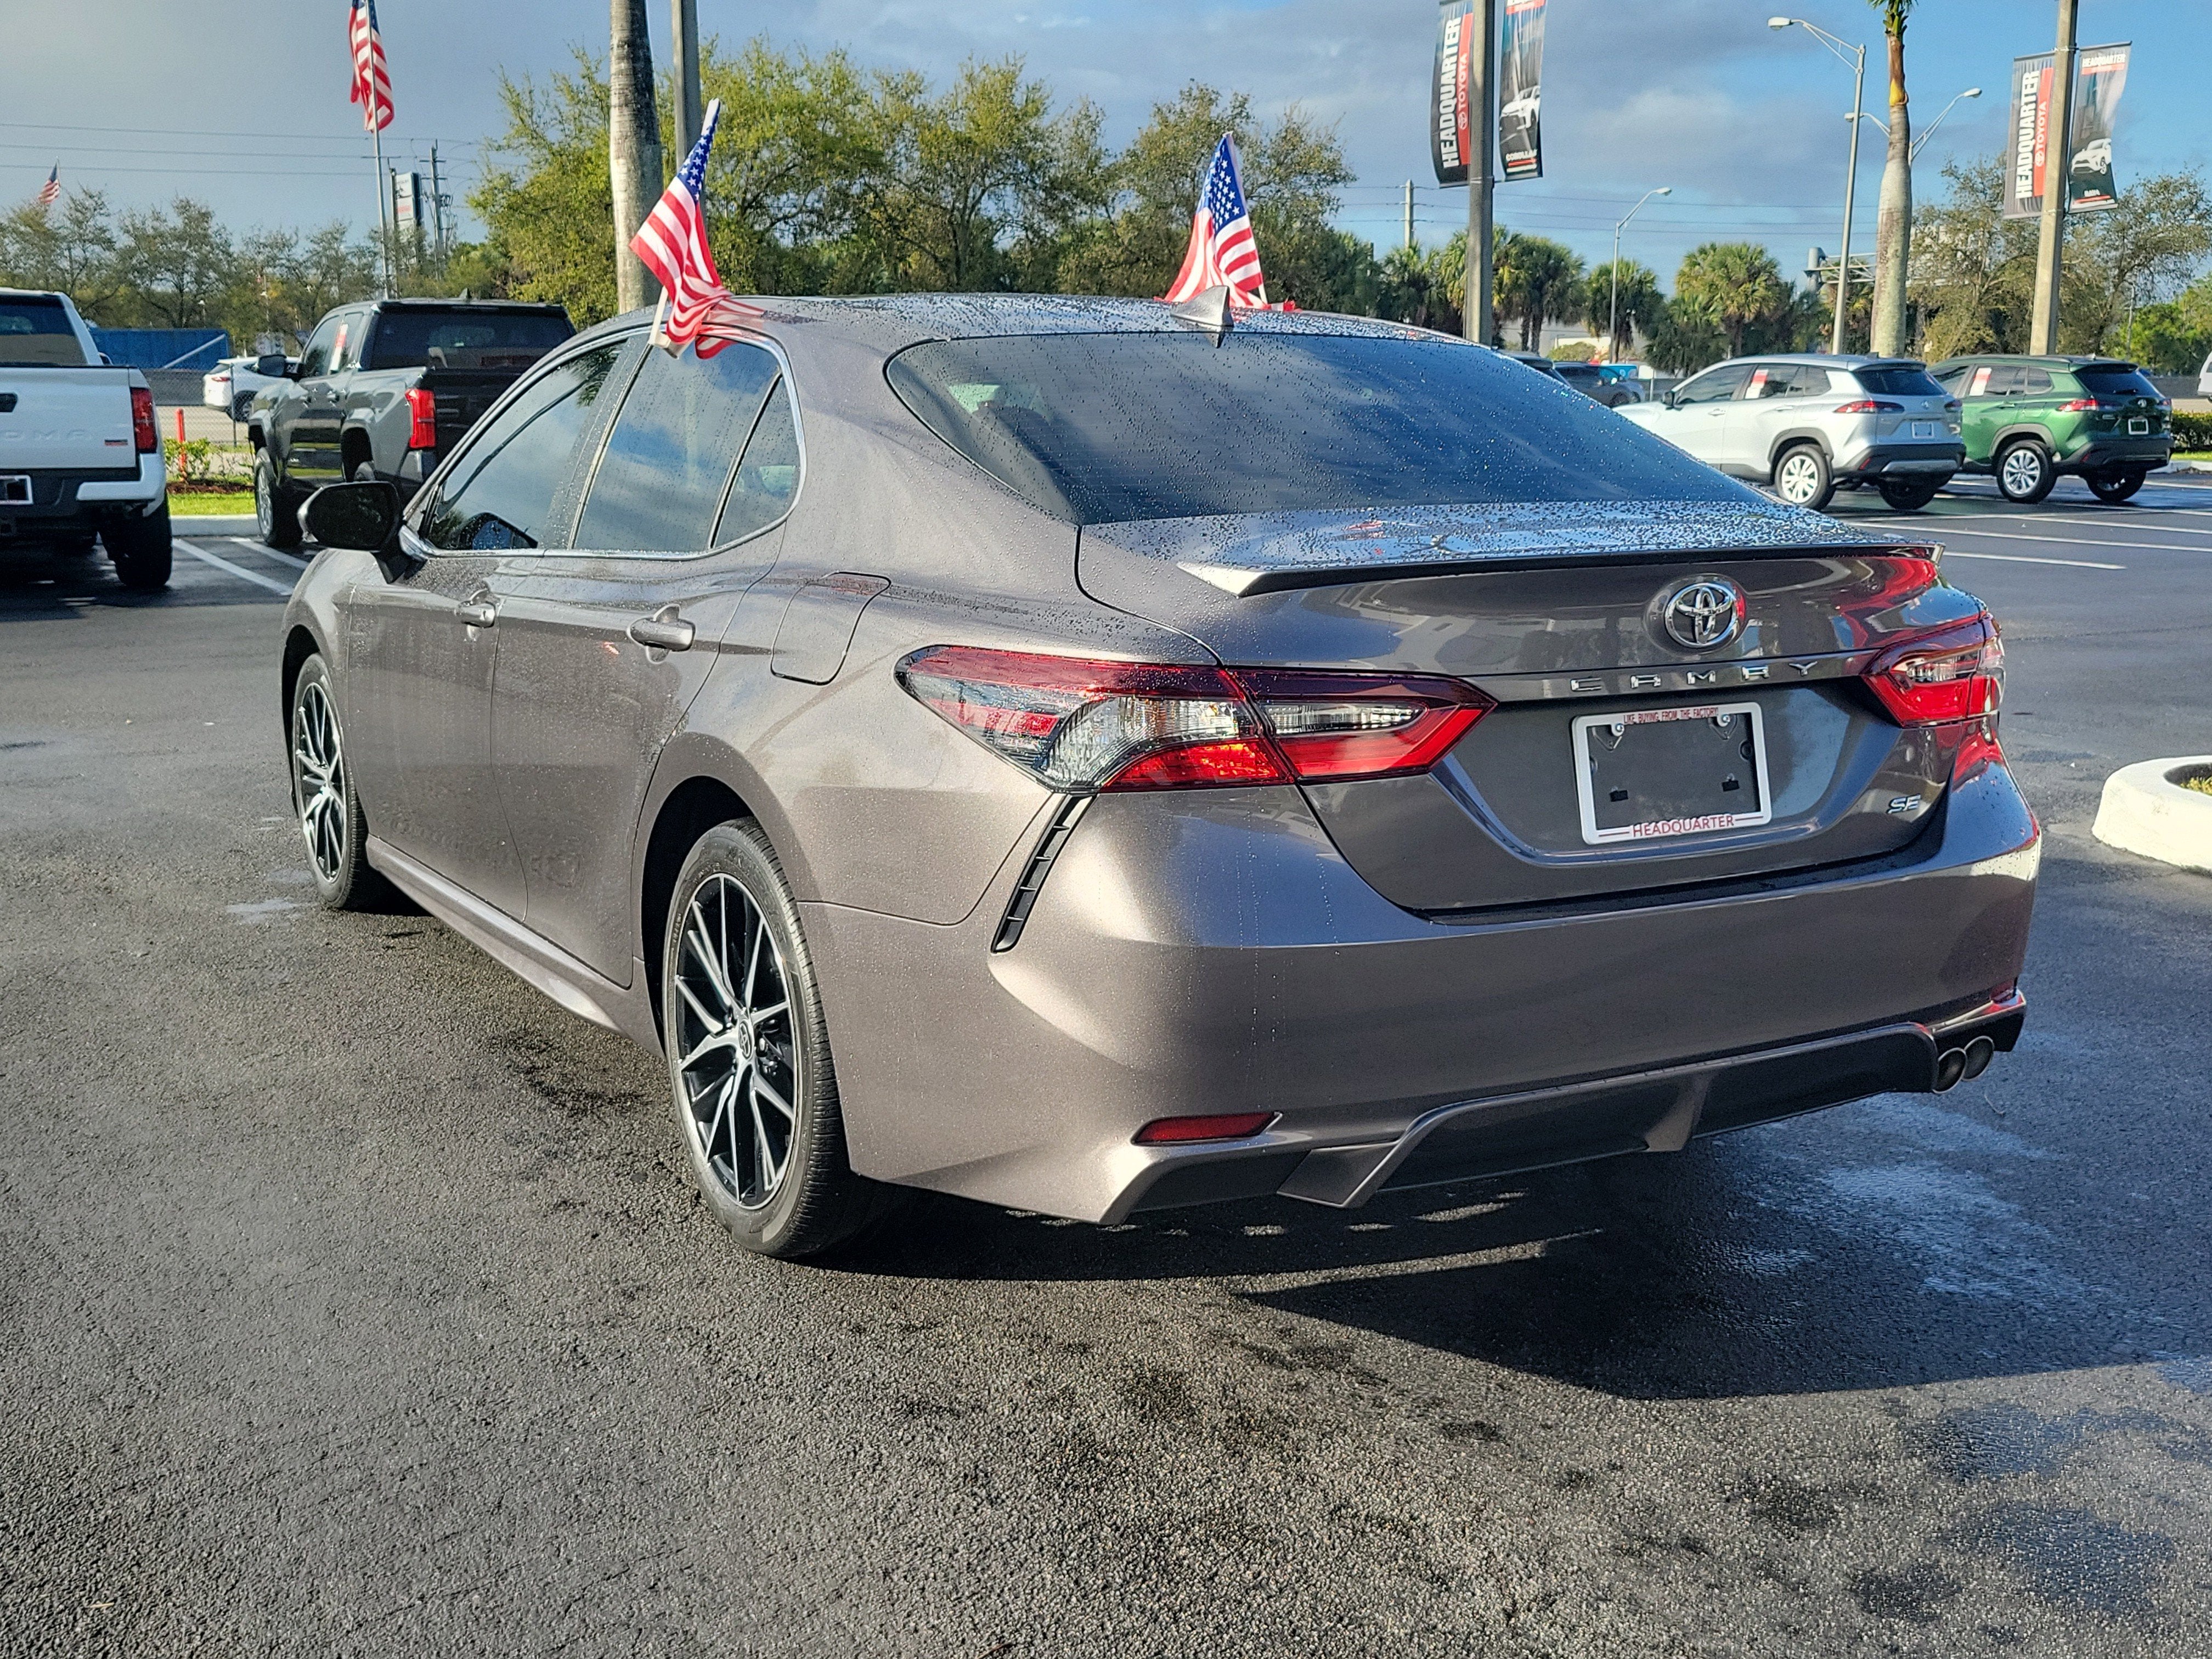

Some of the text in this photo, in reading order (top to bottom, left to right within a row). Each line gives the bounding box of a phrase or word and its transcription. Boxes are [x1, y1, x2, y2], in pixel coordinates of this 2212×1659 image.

[1440, 16, 1461, 168] HEADQUARTER
[1458, 53, 1468, 111] TOYOTA
[2016, 70, 2040, 199] HEADQUARTER
[2036, 101, 2046, 149] TOYOTA
[1570, 661, 1819, 692] CAMRY
[1624, 714, 1636, 725] LIKE
[1638, 712, 1659, 724] BUYING
[1661, 710, 1678, 721] FROM
[1680, 709, 1691, 719] THE
[1886, 793, 1921, 815] SE
[1633, 815, 1734, 837] HEADQUARTER
